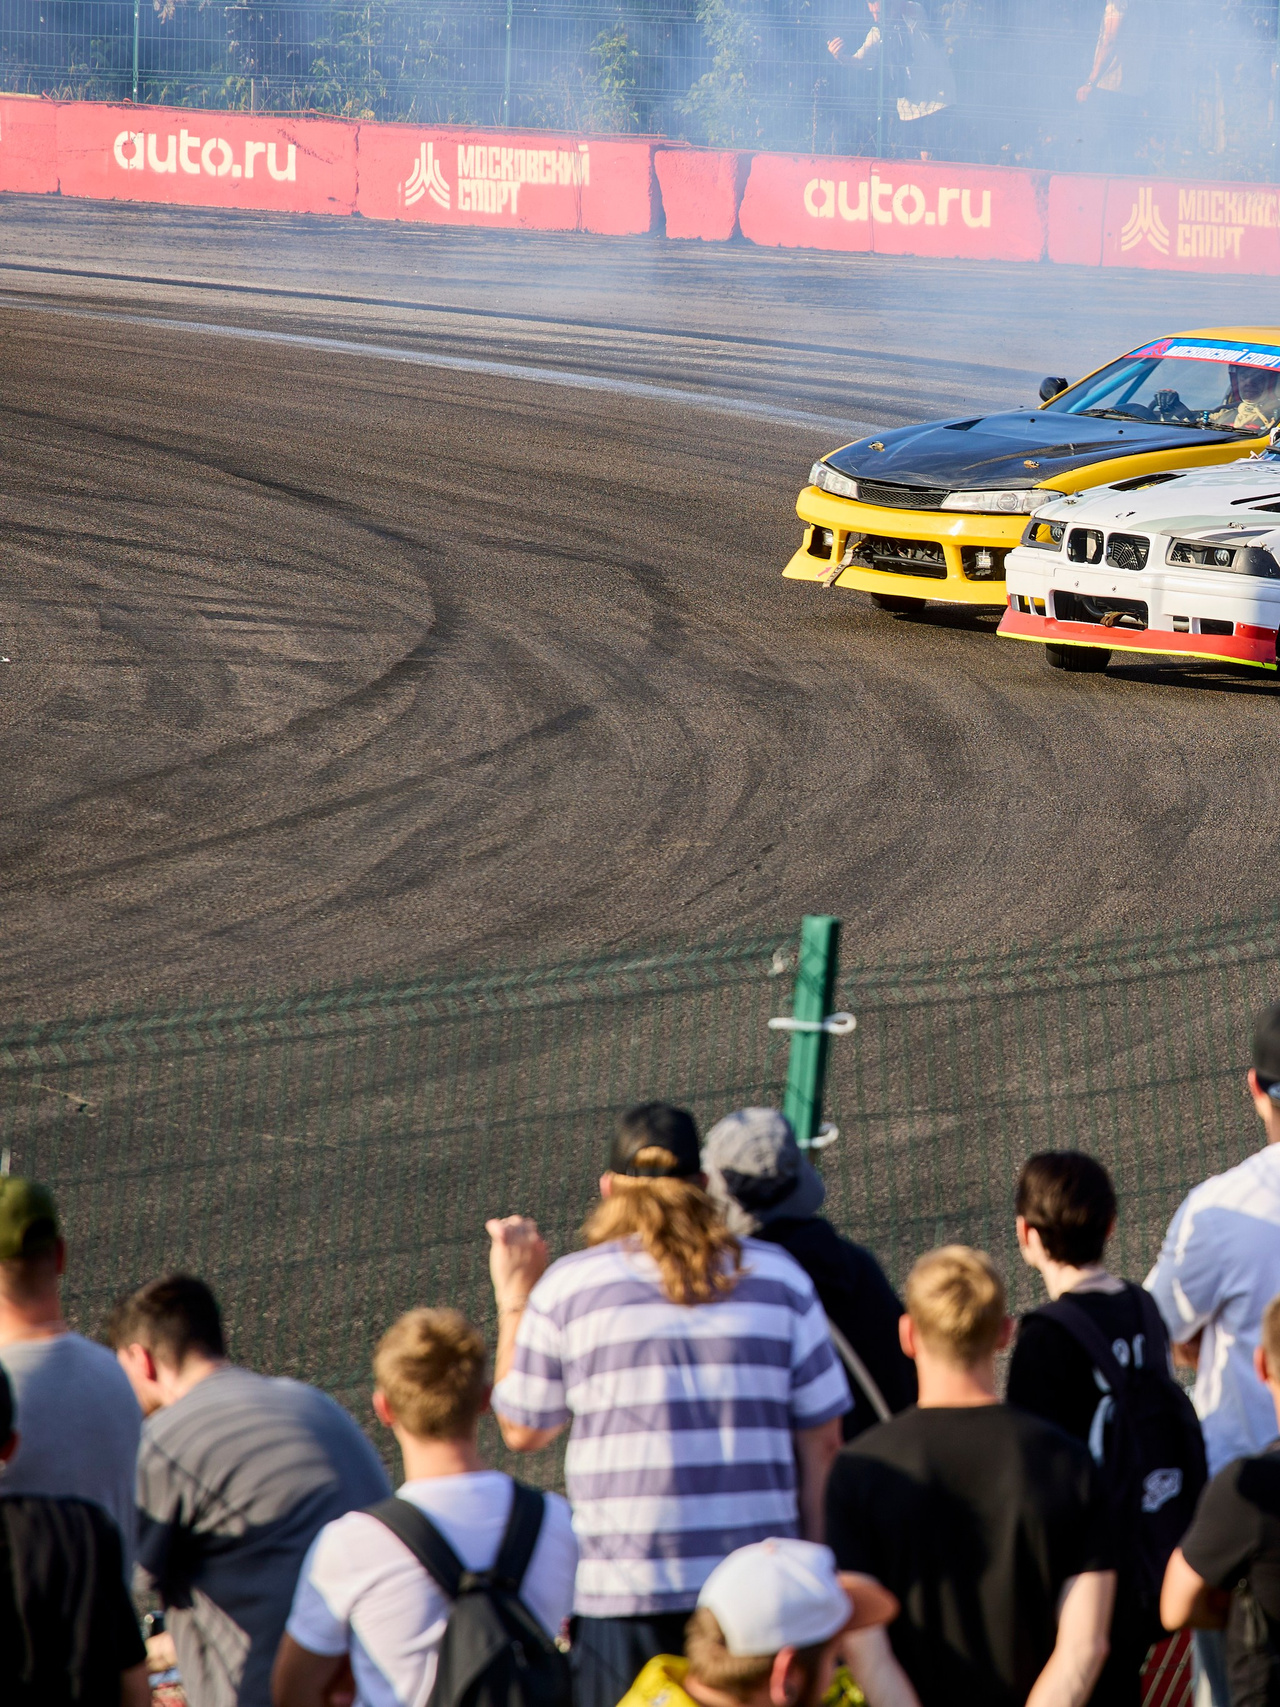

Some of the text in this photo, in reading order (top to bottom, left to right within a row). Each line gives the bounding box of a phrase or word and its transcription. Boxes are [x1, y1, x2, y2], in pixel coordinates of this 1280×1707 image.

[113, 127, 297, 182] auto.ru
[457, 144, 590, 187] МОСКОВСКИЙ
[457, 178, 521, 214] СПОРТ
[803, 174, 992, 229] auto.ru
[1176, 223, 1245, 260] СПОРТ
